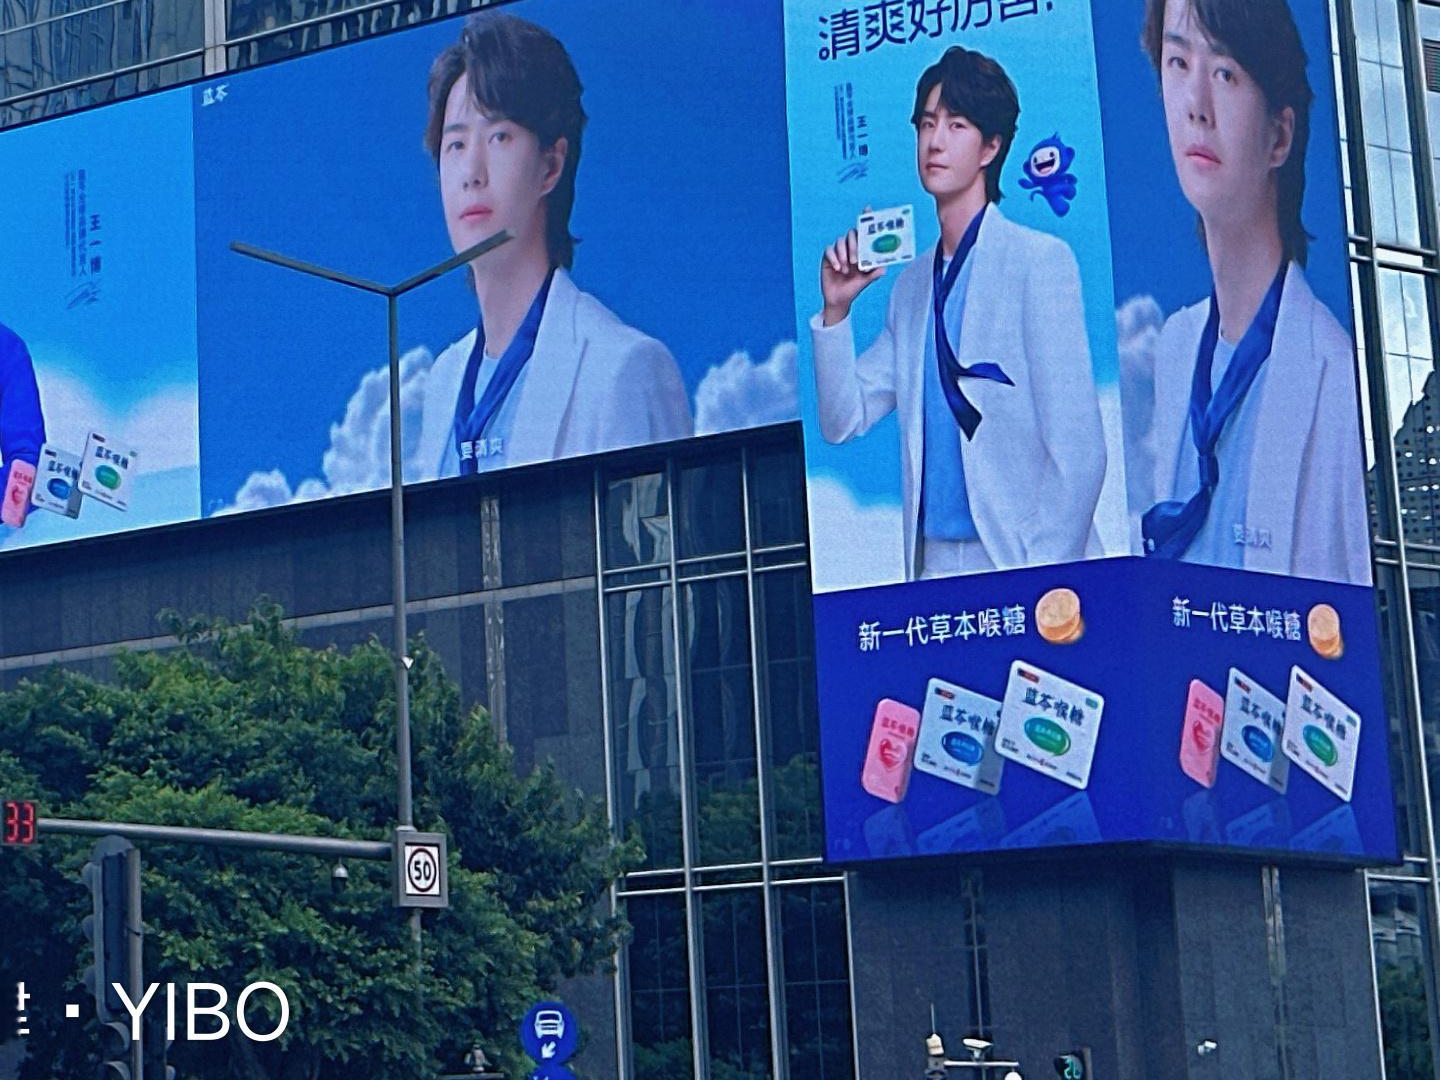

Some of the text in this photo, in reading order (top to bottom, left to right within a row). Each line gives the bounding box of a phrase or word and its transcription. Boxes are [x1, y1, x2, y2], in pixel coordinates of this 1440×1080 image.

[858, 603, 1026, 652] 新一代草本喉糖
[1171, 596, 1302, 642] 新一代草本喉糖
[5, 802, 35, 845] 33
[413, 860, 431, 881] 50
